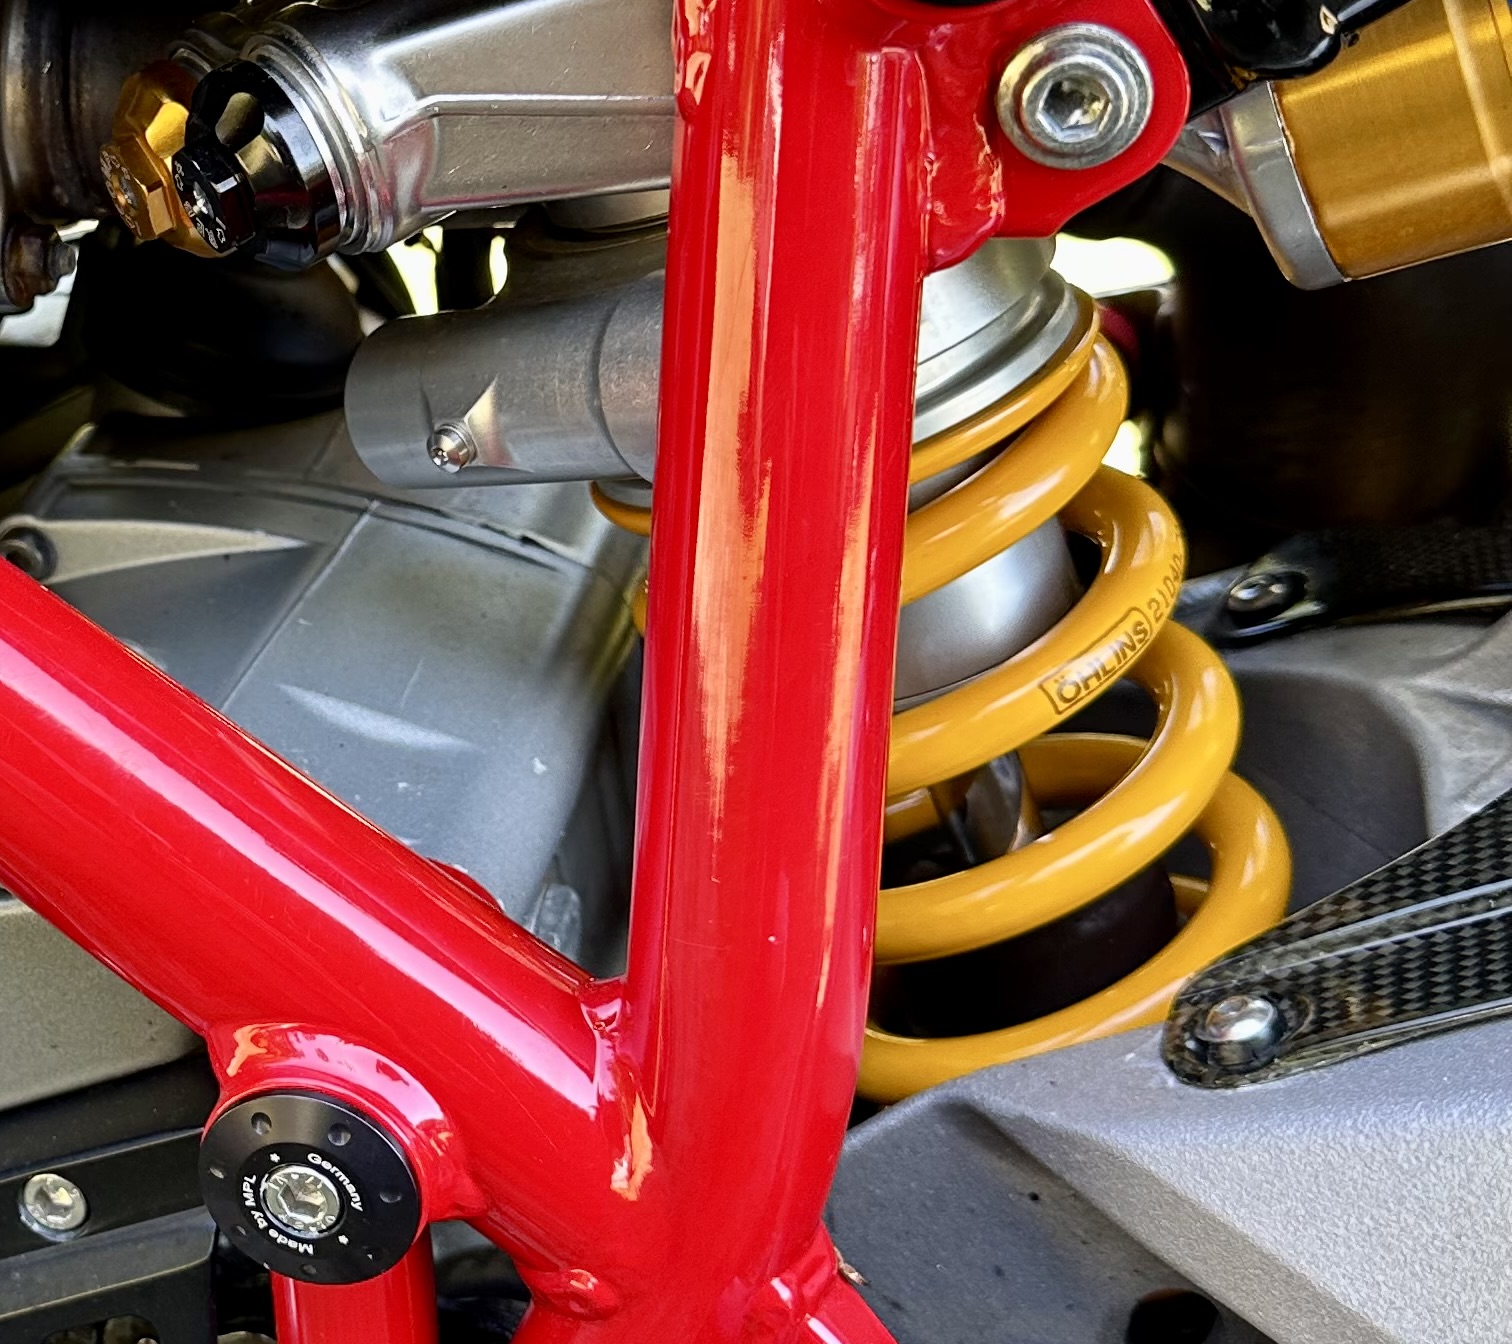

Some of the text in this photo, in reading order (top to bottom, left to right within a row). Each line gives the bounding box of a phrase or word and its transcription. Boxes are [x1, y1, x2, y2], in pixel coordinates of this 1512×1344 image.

[242, 1174, 314, 1256] Made by MPL
[307, 1153, 363, 1212] Germany
